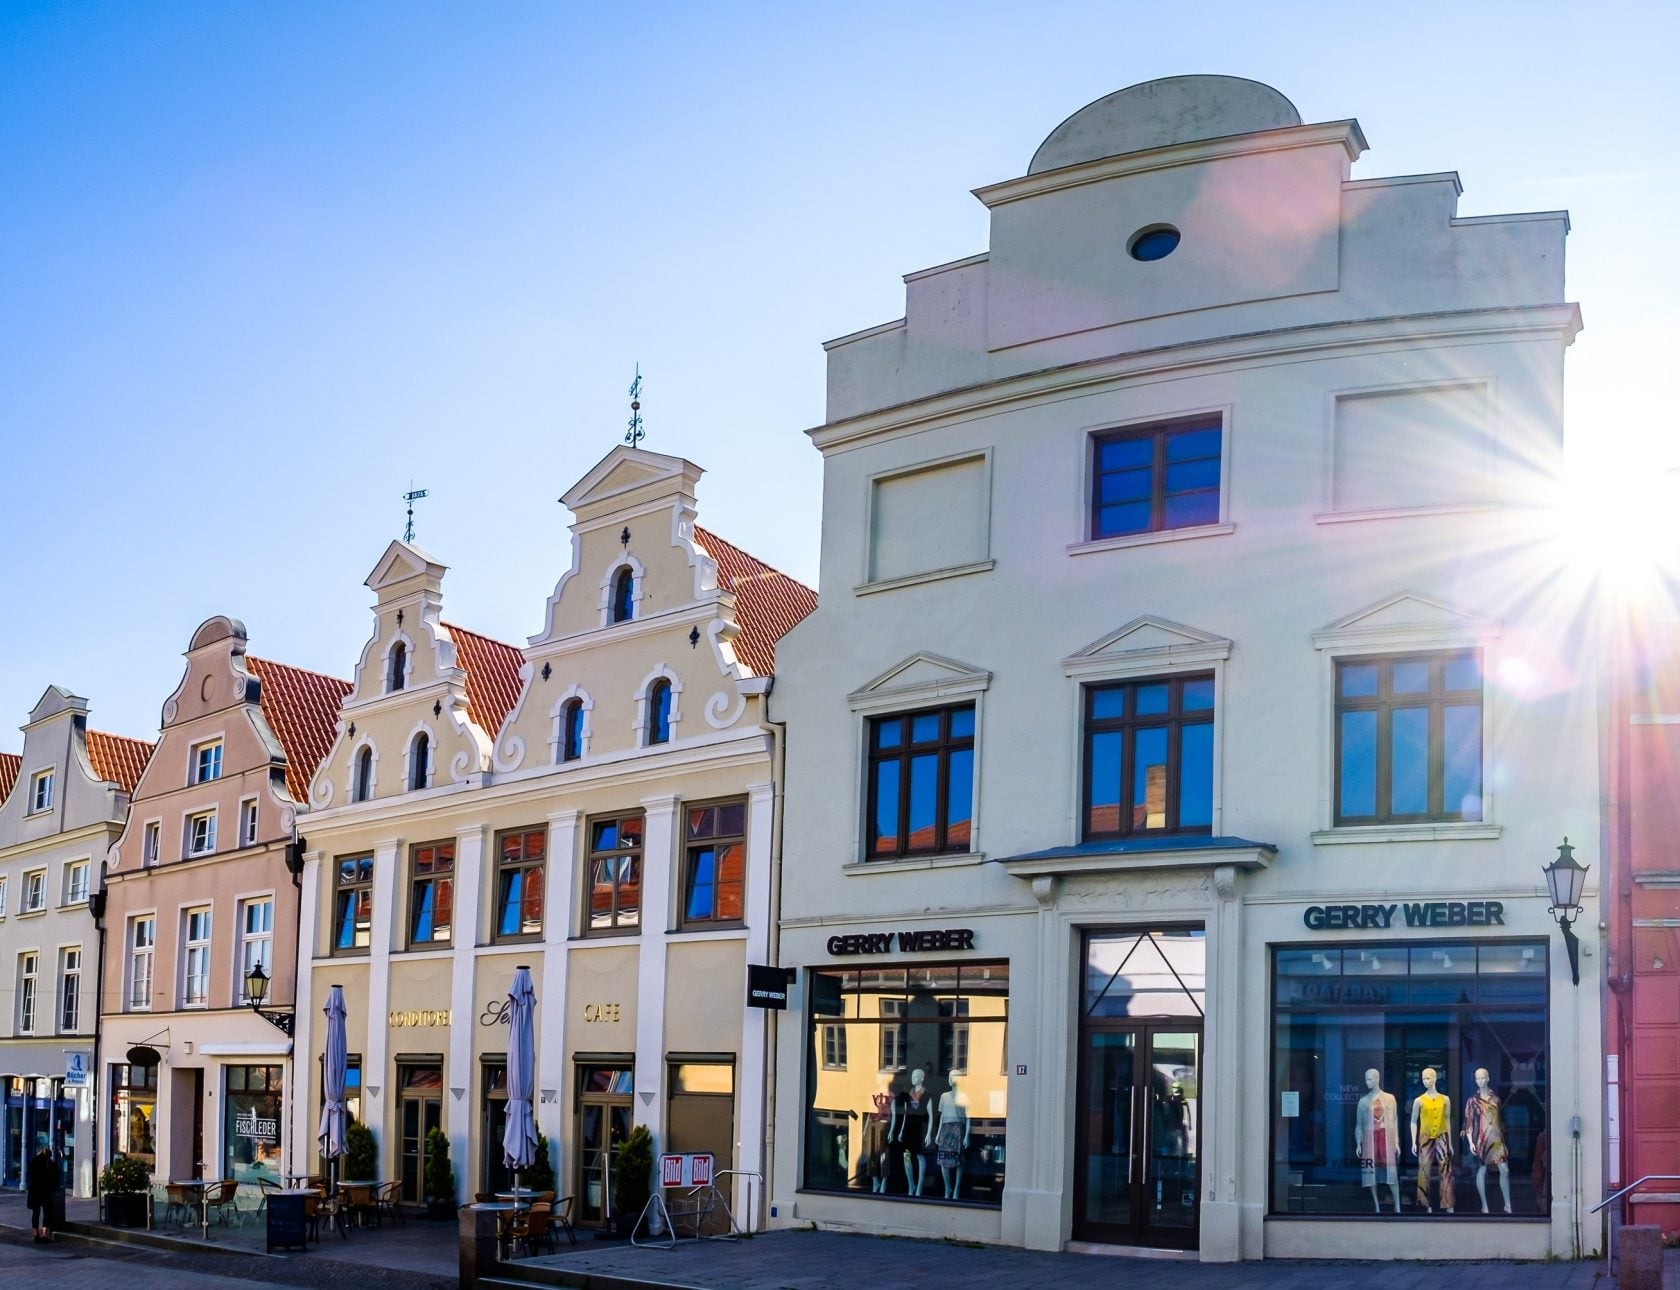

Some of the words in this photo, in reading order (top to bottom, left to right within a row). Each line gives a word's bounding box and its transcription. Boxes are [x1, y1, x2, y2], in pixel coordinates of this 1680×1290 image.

[1303, 904, 1398, 930] GERRY
[1403, 901, 1506, 928] WEBER
[827, 933, 895, 956] GERRY
[898, 928, 975, 953] WEBER
[752, 989, 768, 998] GERRY
[769, 991, 786, 1000] WEBER
[389, 1009, 452, 1028] CONDITOREI
[66, 1071, 87, 1079] Bücher
[1323, 1092, 1360, 1101] COLLECT
[235, 1120, 277, 1136] FISCHLEDER
[664, 1158, 682, 1183] Bild
[693, 1158, 710, 1182] Bild
